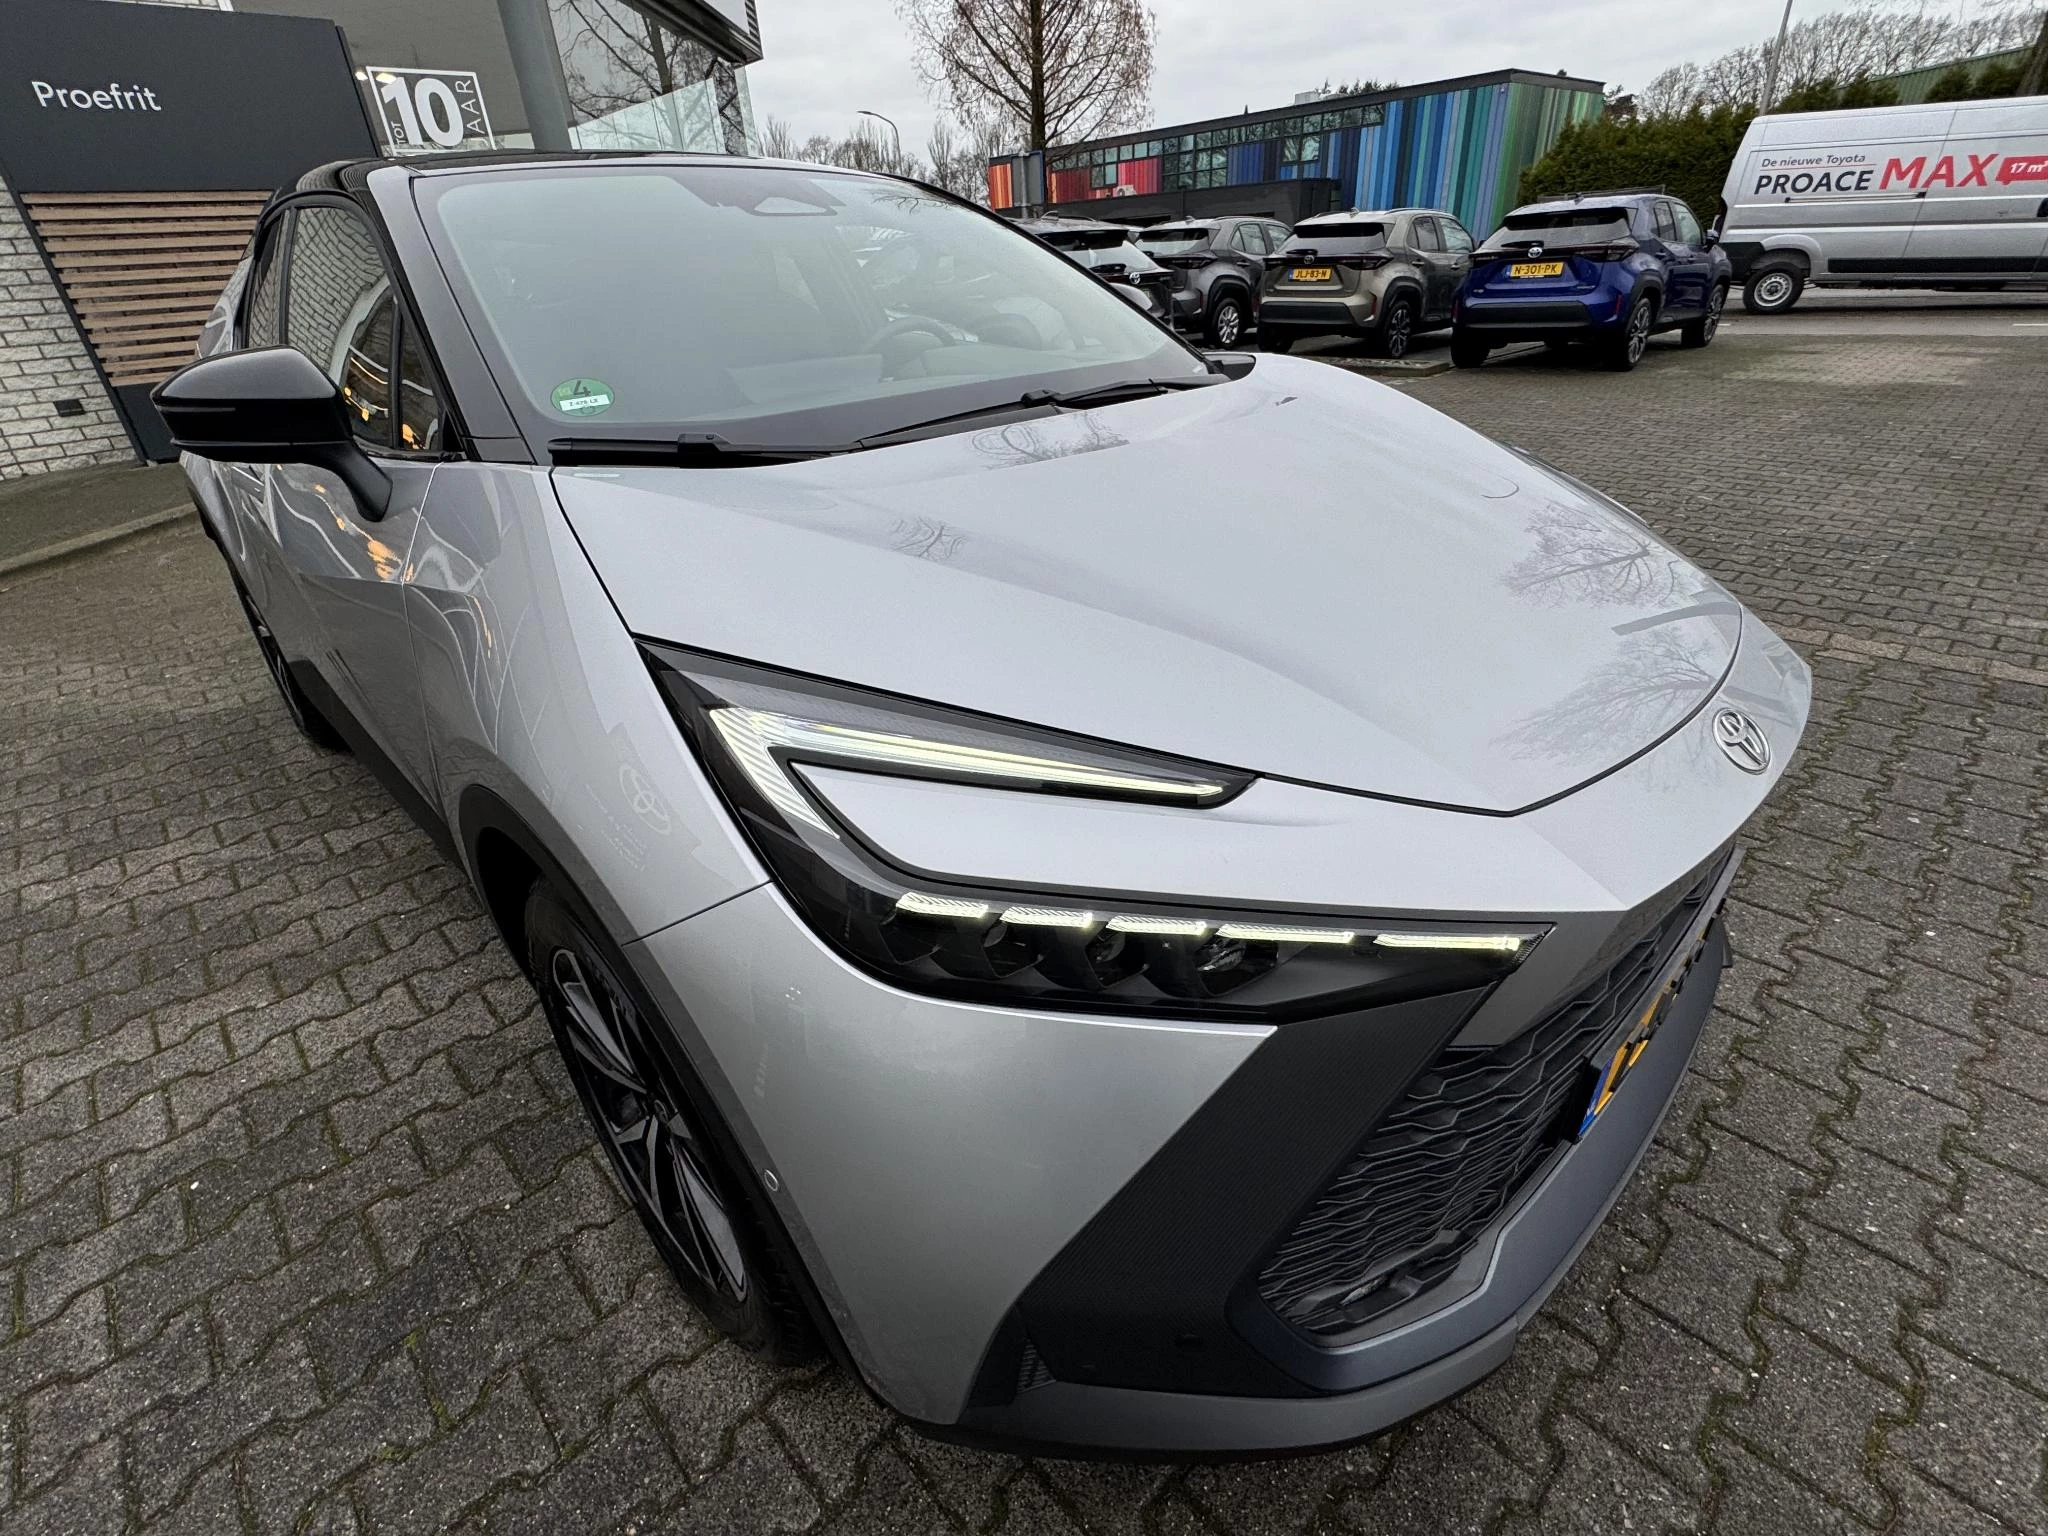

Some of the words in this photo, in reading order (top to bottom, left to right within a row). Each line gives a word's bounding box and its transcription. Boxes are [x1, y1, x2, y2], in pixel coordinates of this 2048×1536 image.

[31, 81, 161, 111] Proefrit
[381, 77, 464, 147] 10
[455, 80, 489, 147] JAAR
[391, 121, 406, 145] TOT
[1761, 158, 1777, 168] De
[1780, 156, 1822, 167] nieuwe
[1826, 154, 1866, 166] Toyota
[2010, 162, 2027, 174] 17
[1754, 170, 1874, 195] PROACE
[1879, 153, 1999, 190] MAX
[1514, 264, 1557, 275] N-301-PK
[573, 380, 591, 397] 4
